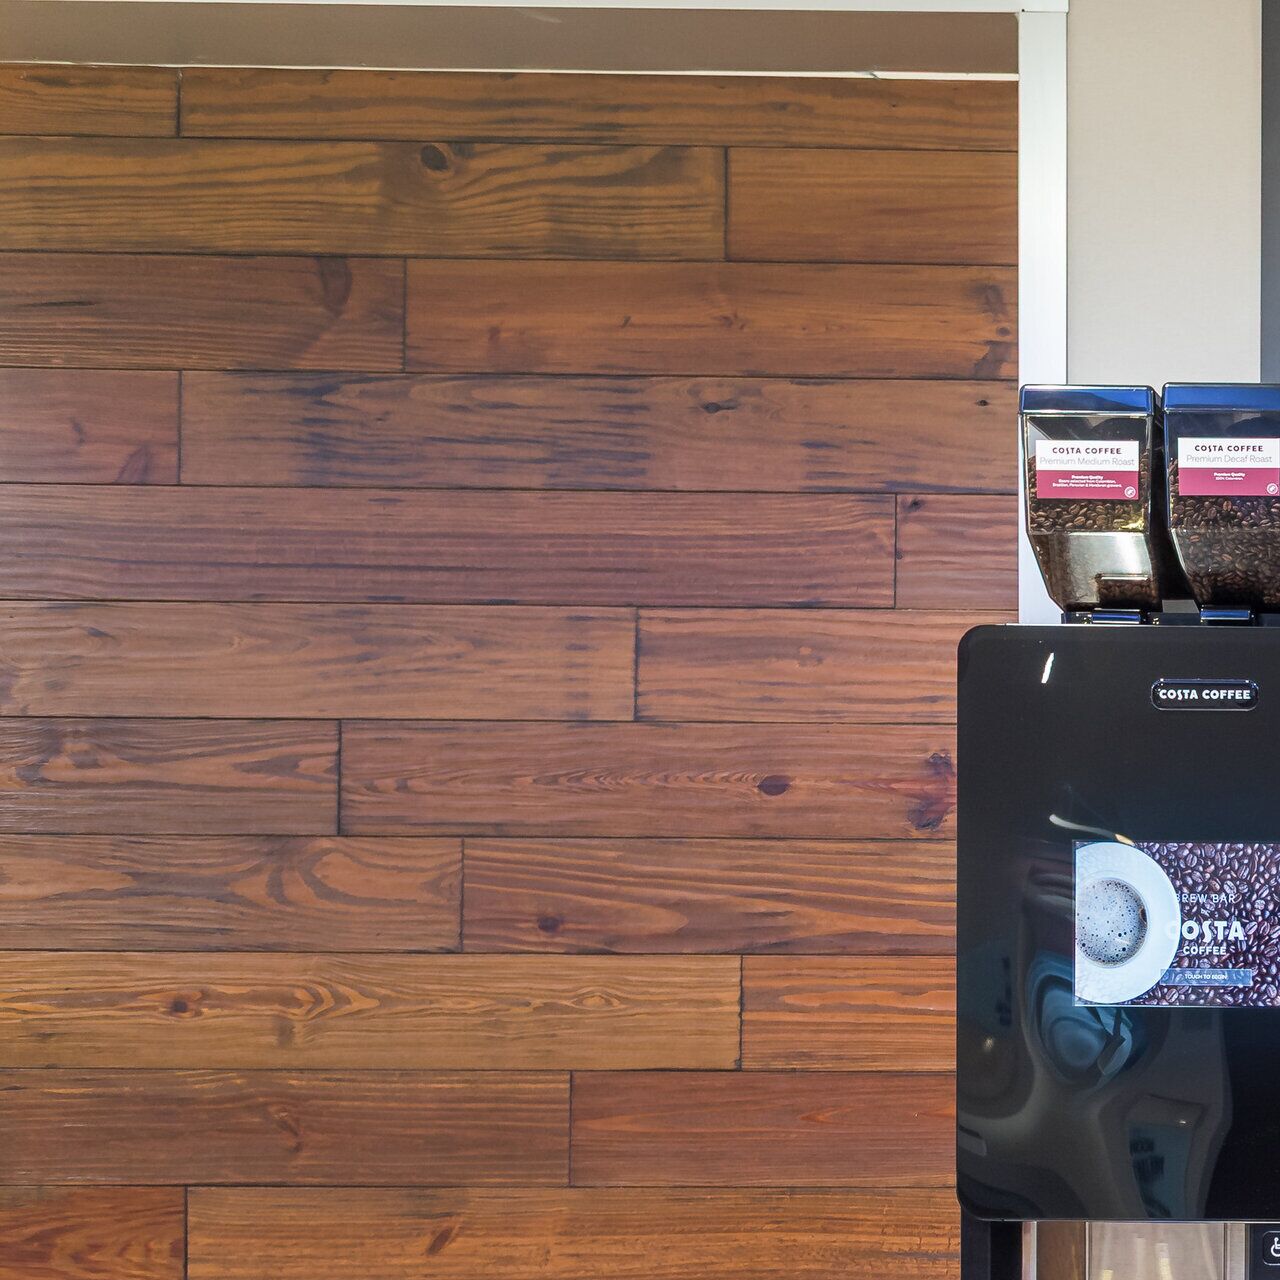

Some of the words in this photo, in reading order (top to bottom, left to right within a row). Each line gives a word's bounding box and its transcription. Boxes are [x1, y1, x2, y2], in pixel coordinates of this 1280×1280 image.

[1052, 447, 1082, 455] COSTA
[1085, 447, 1122, 455] COFFEE
[1040, 457, 1077, 466] Premium
[1078, 457, 1111, 466] Medium
[1112, 457, 1135, 466] Roast
[1186, 455, 1223, 463] Premium
[1224, 454, 1248, 463] Decaf
[1250, 454, 1272, 463] Roast
[1158, 689, 1199, 701] COSTA
[1202, 689, 1251, 700] COFFEE
[1212, 893, 1236, 903] BAR
[1183, 946, 1227, 955] COFFEE
